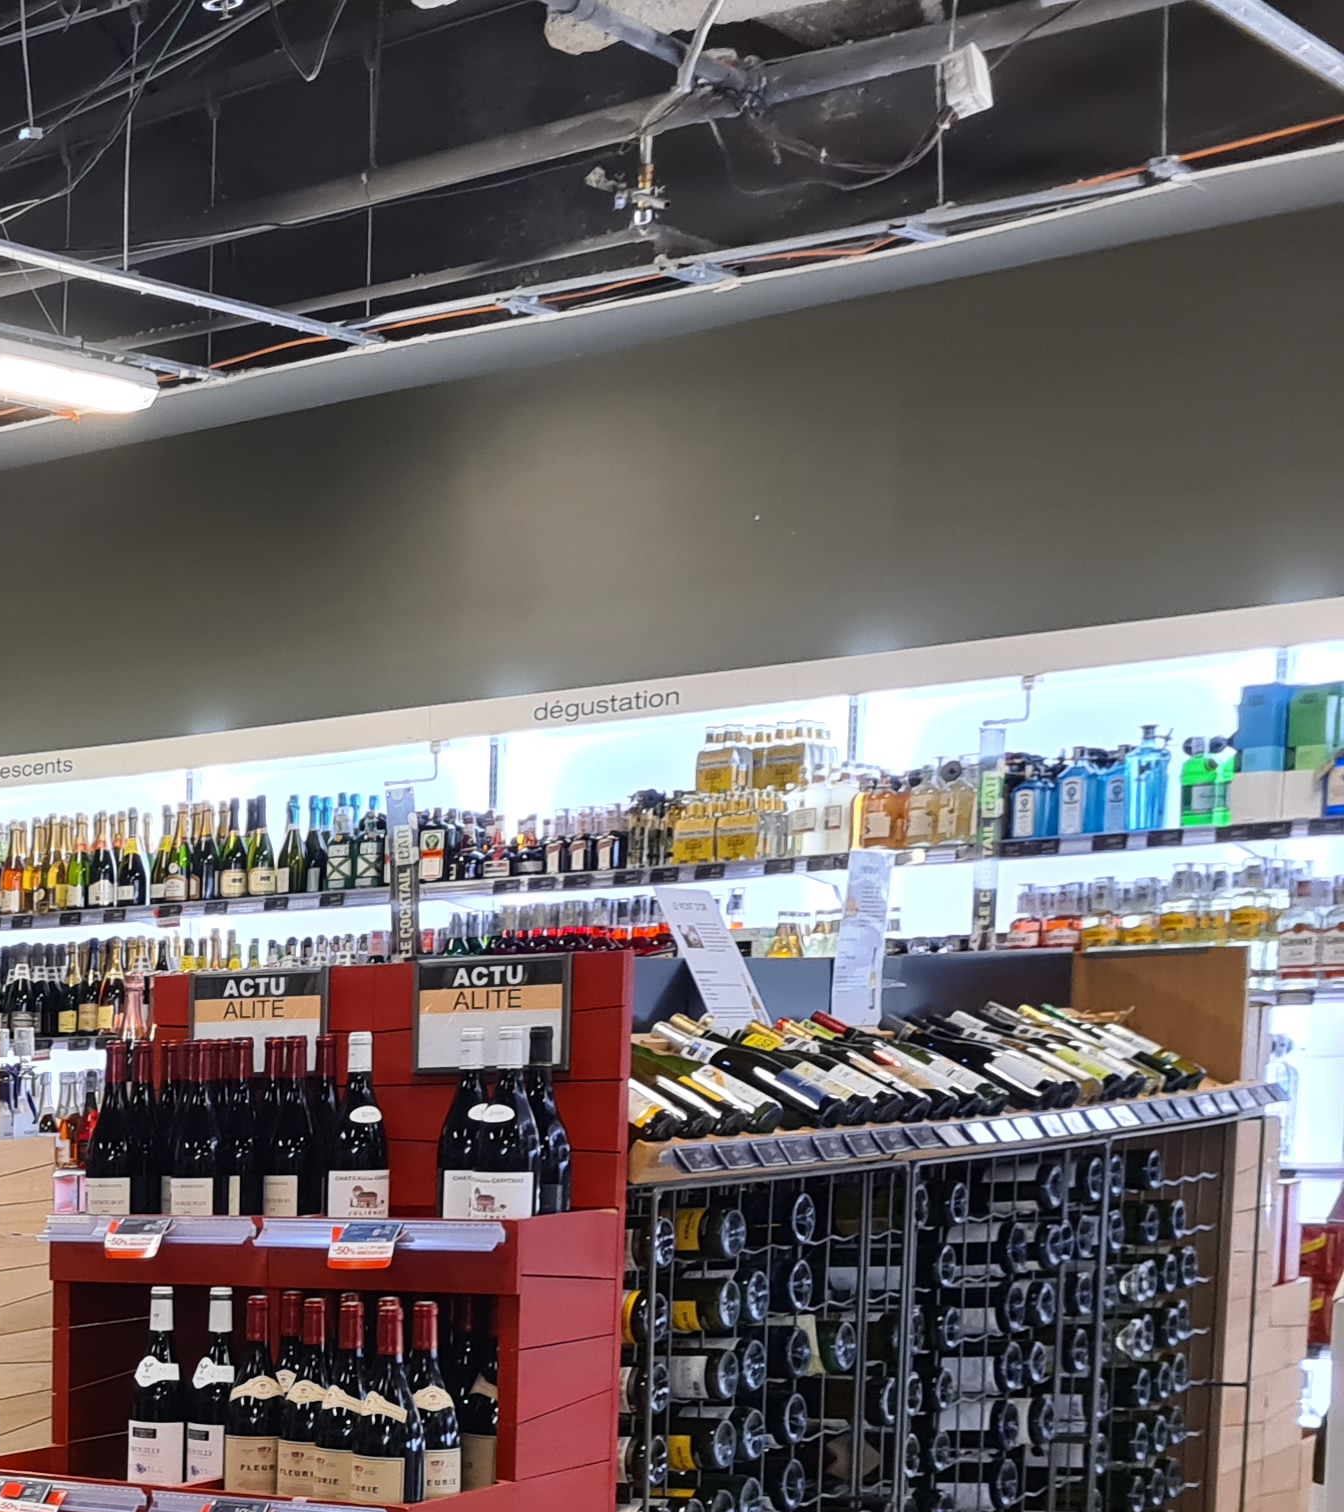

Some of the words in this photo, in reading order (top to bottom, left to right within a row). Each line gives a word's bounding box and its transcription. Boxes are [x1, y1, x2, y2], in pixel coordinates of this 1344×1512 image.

[534, 690, 680, 722] dégustation
[399, 867, 413, 938] COCKTAIL
[223, 976, 286, 997] ACTU
[453, 965, 524, 988] ACTU
